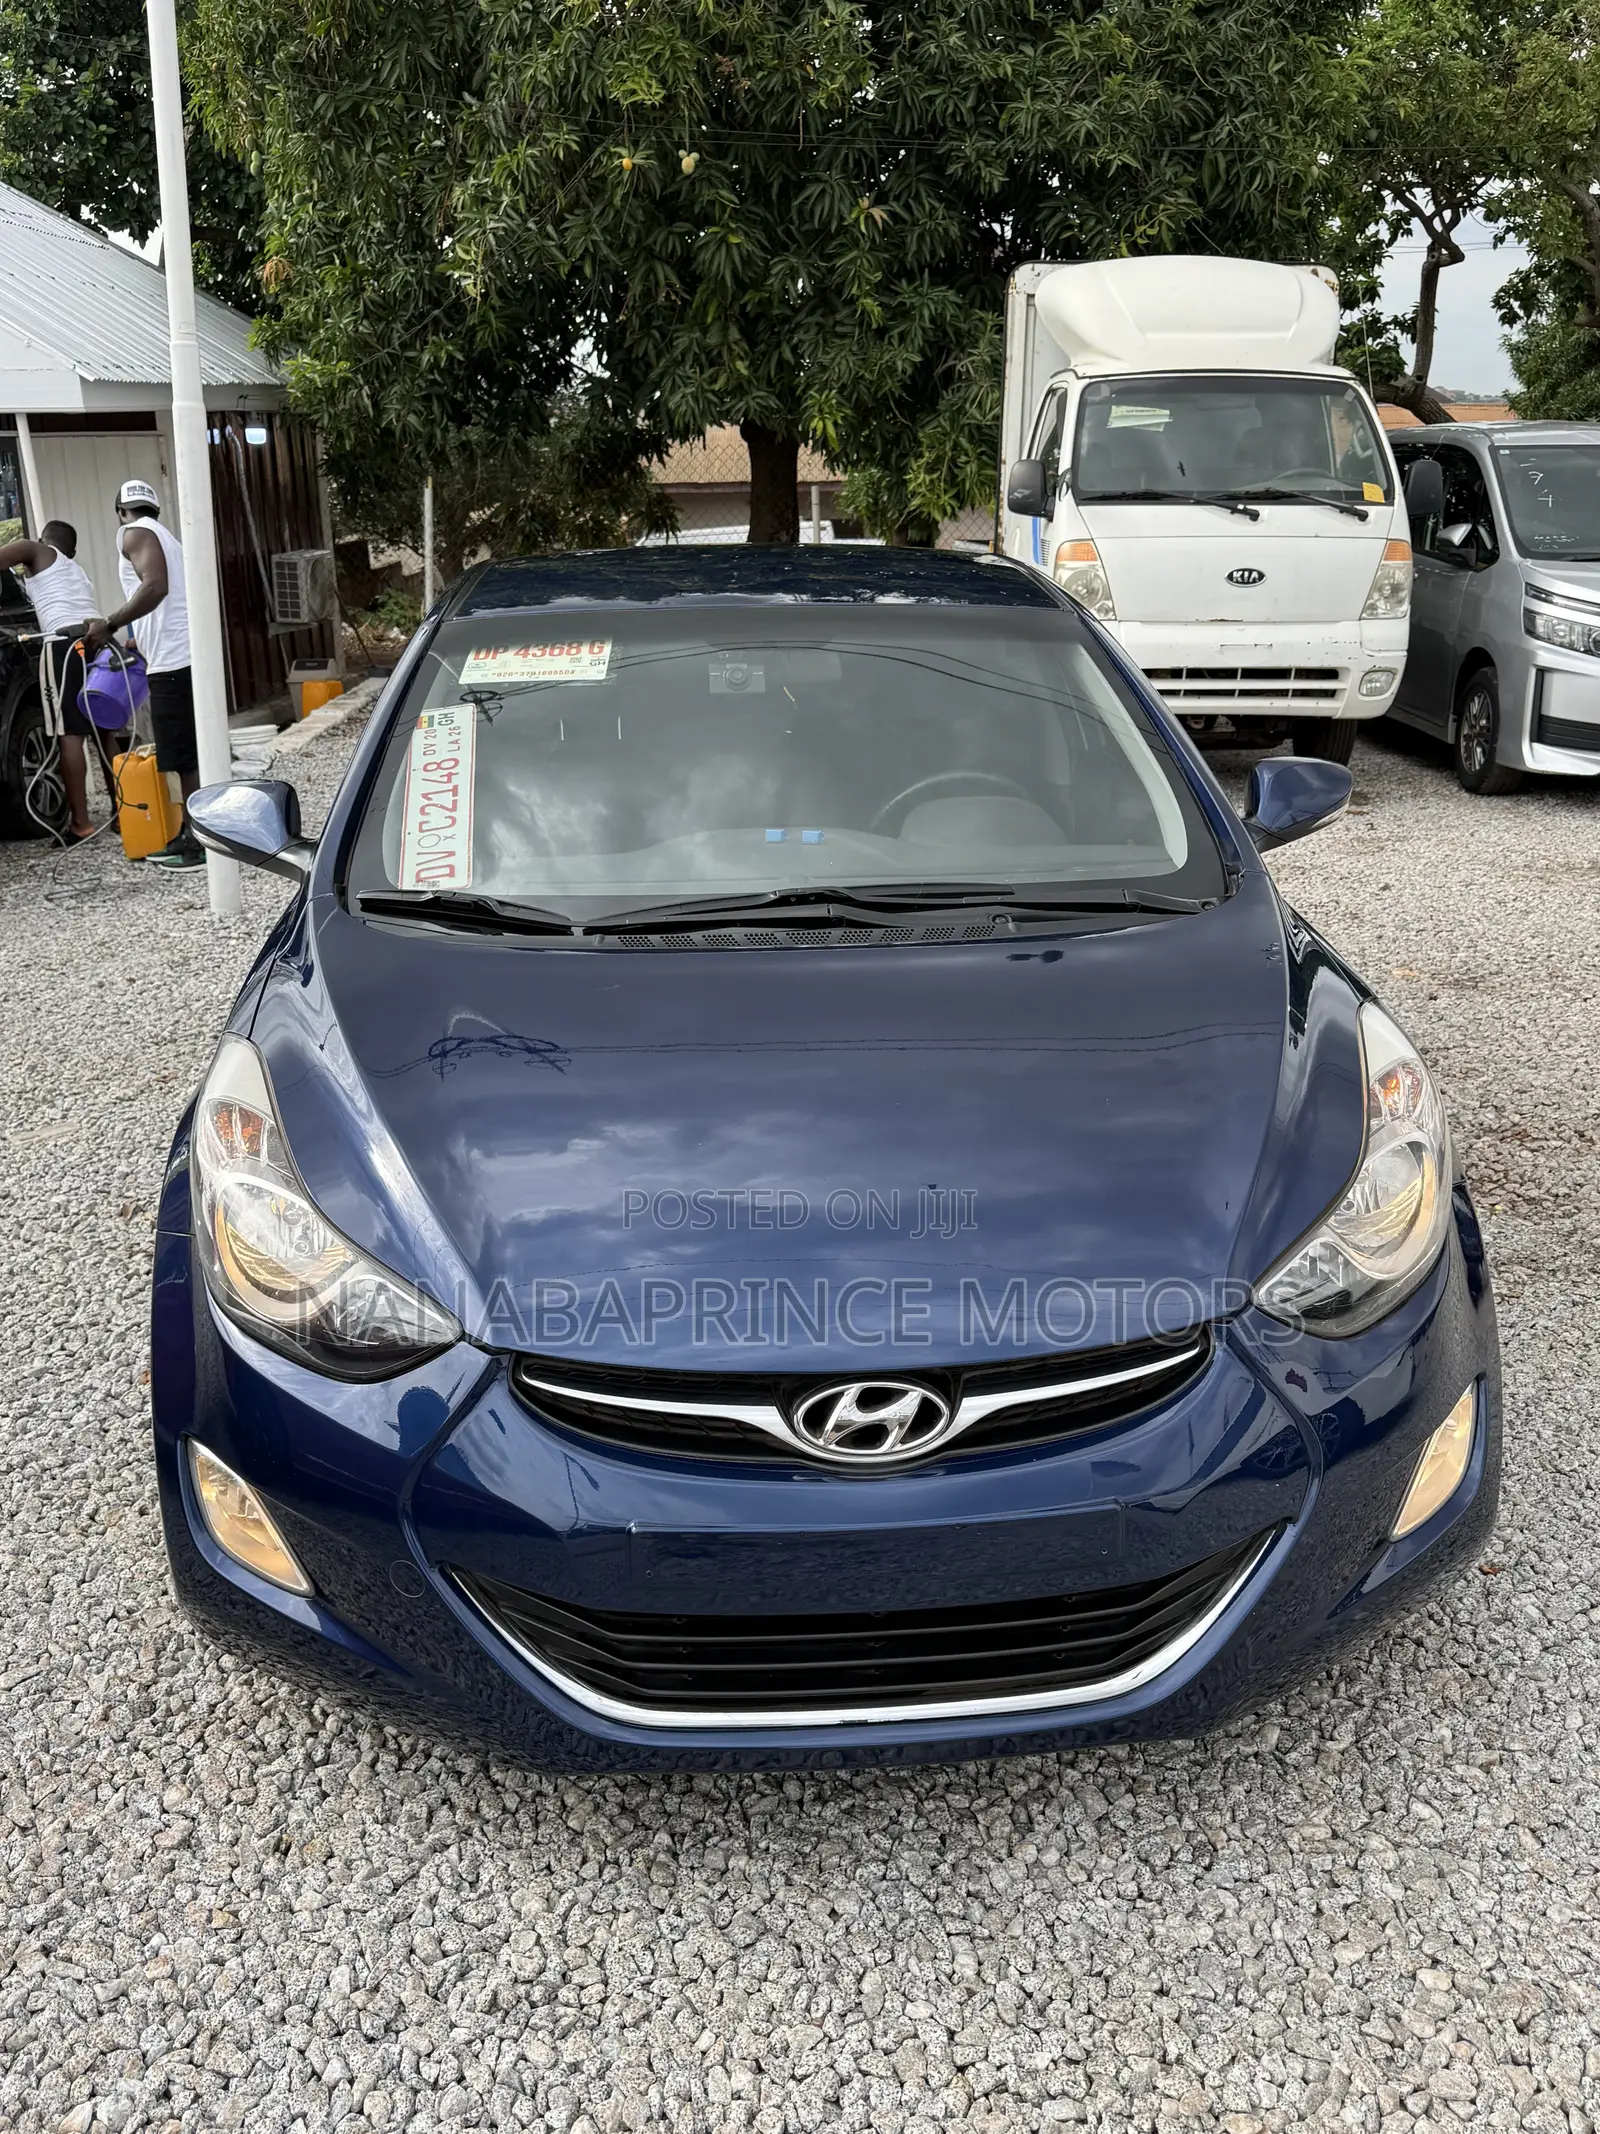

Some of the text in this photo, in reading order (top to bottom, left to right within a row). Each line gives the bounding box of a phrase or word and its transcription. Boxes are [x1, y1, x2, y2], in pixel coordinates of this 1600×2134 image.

[1232, 570, 1260, 583] KIA
[473, 639, 606, 661] DP 4368 G
[437, 711, 455, 727] GH
[422, 728, 437, 757] DV 20
[447, 738, 461, 753] LA
[415, 850, 456, 883] DV
